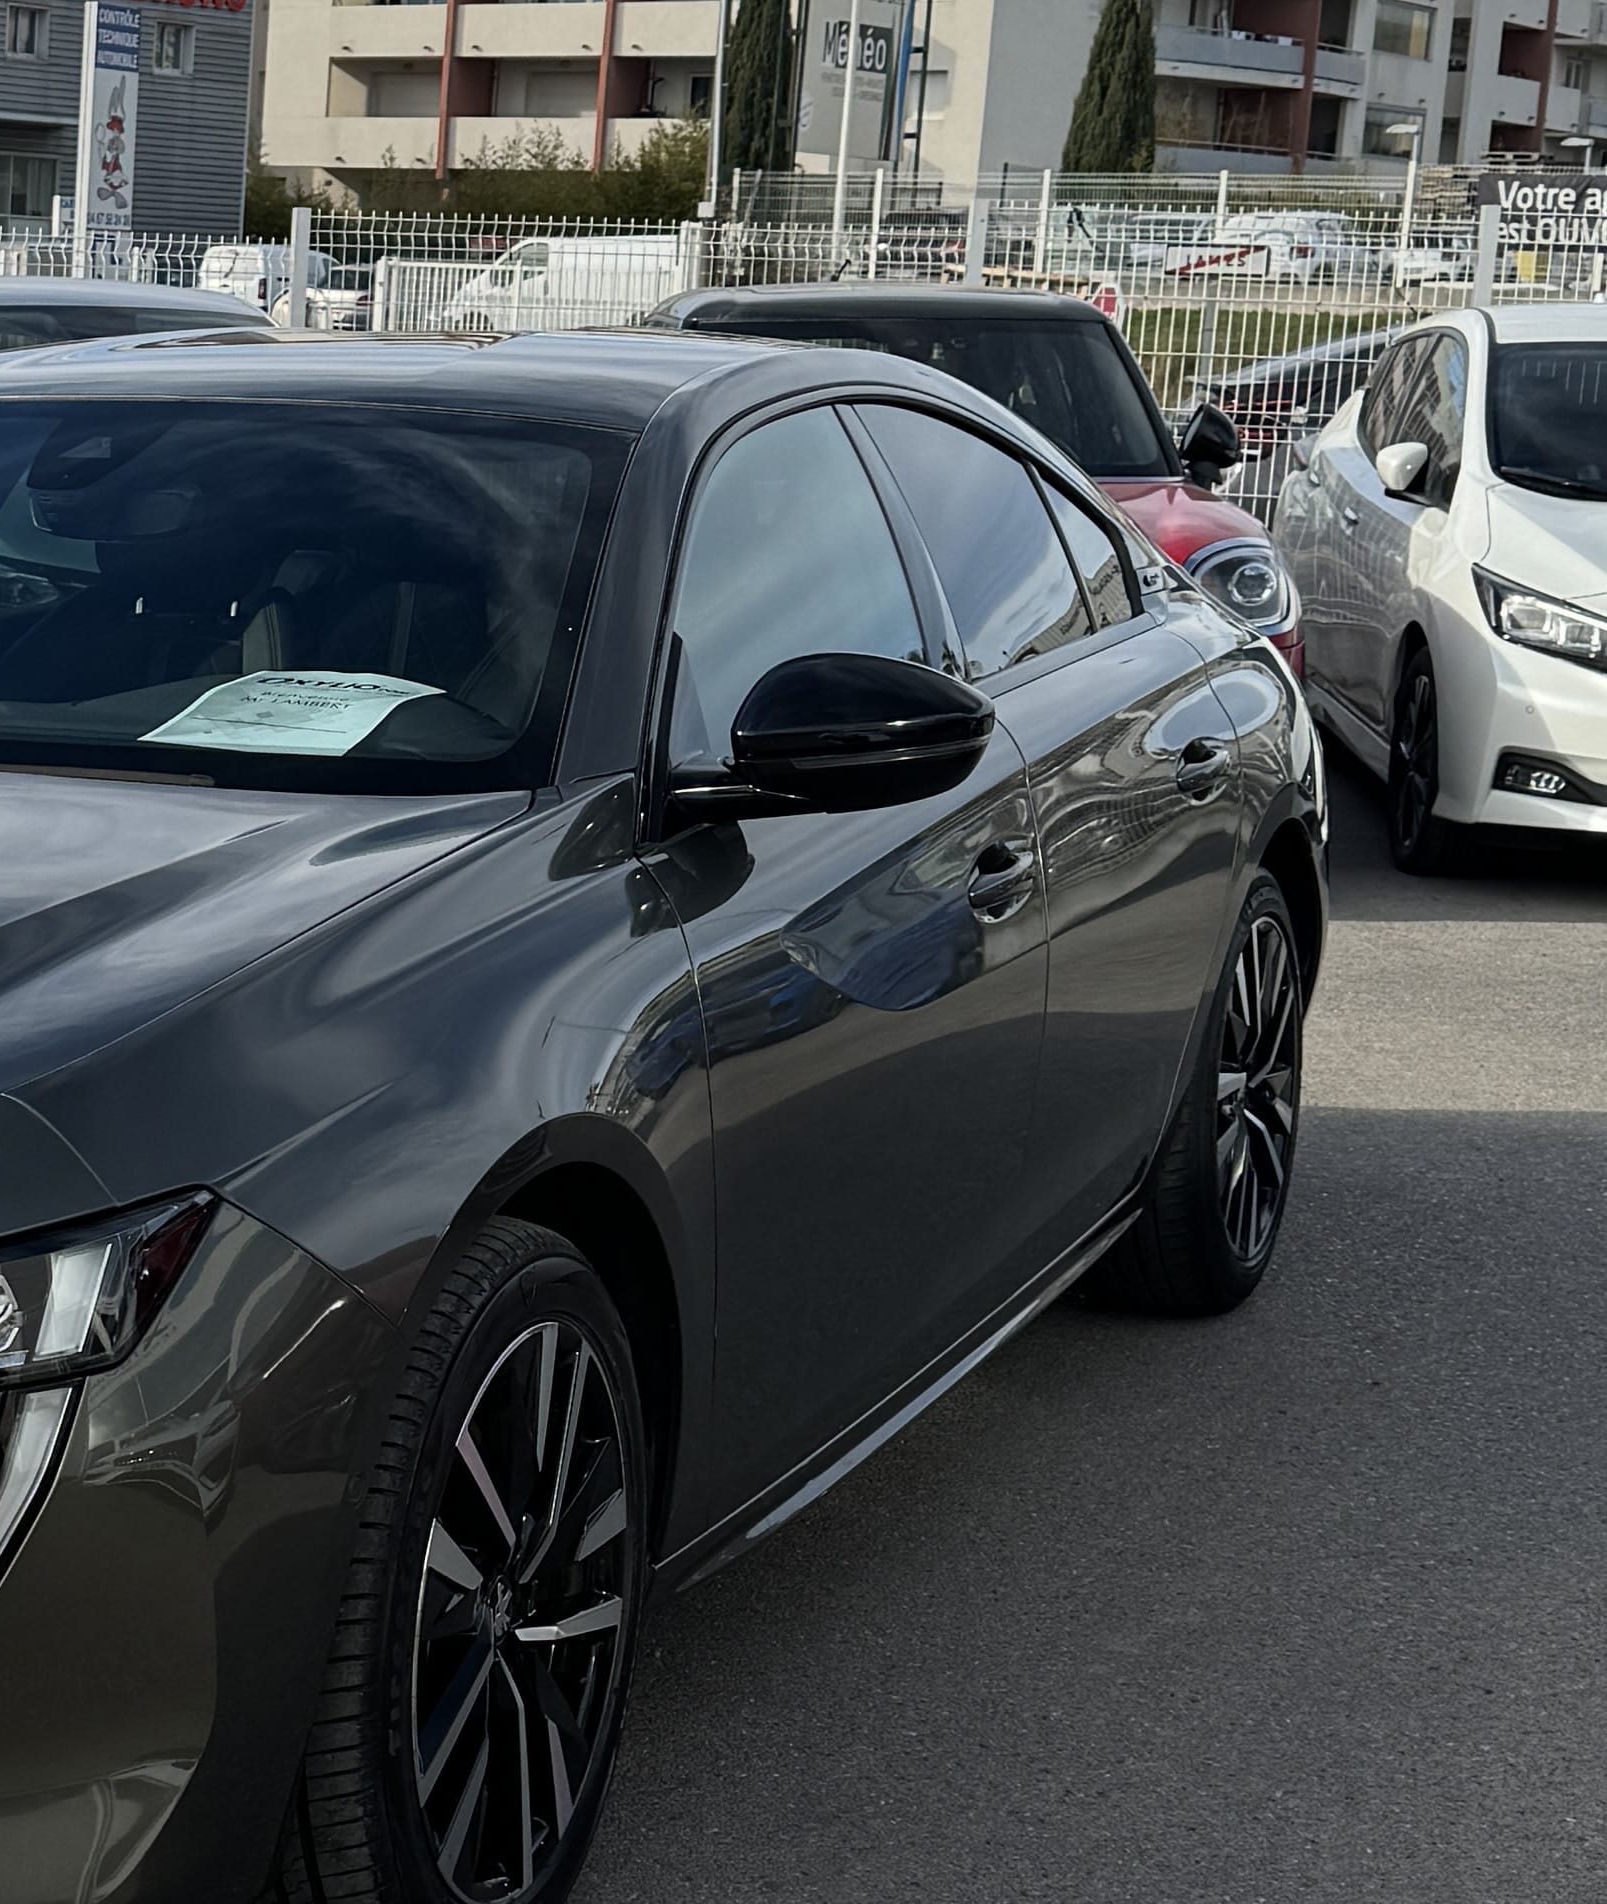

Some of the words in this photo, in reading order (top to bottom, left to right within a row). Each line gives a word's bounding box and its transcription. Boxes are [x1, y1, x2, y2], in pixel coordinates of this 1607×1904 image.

[98, 7, 140, 28] CONTRÔLE
[1497, 180, 1577, 211] Votre
[1498, 218, 1531, 244] est
[272, 696, 354, 709] LAMBERT
